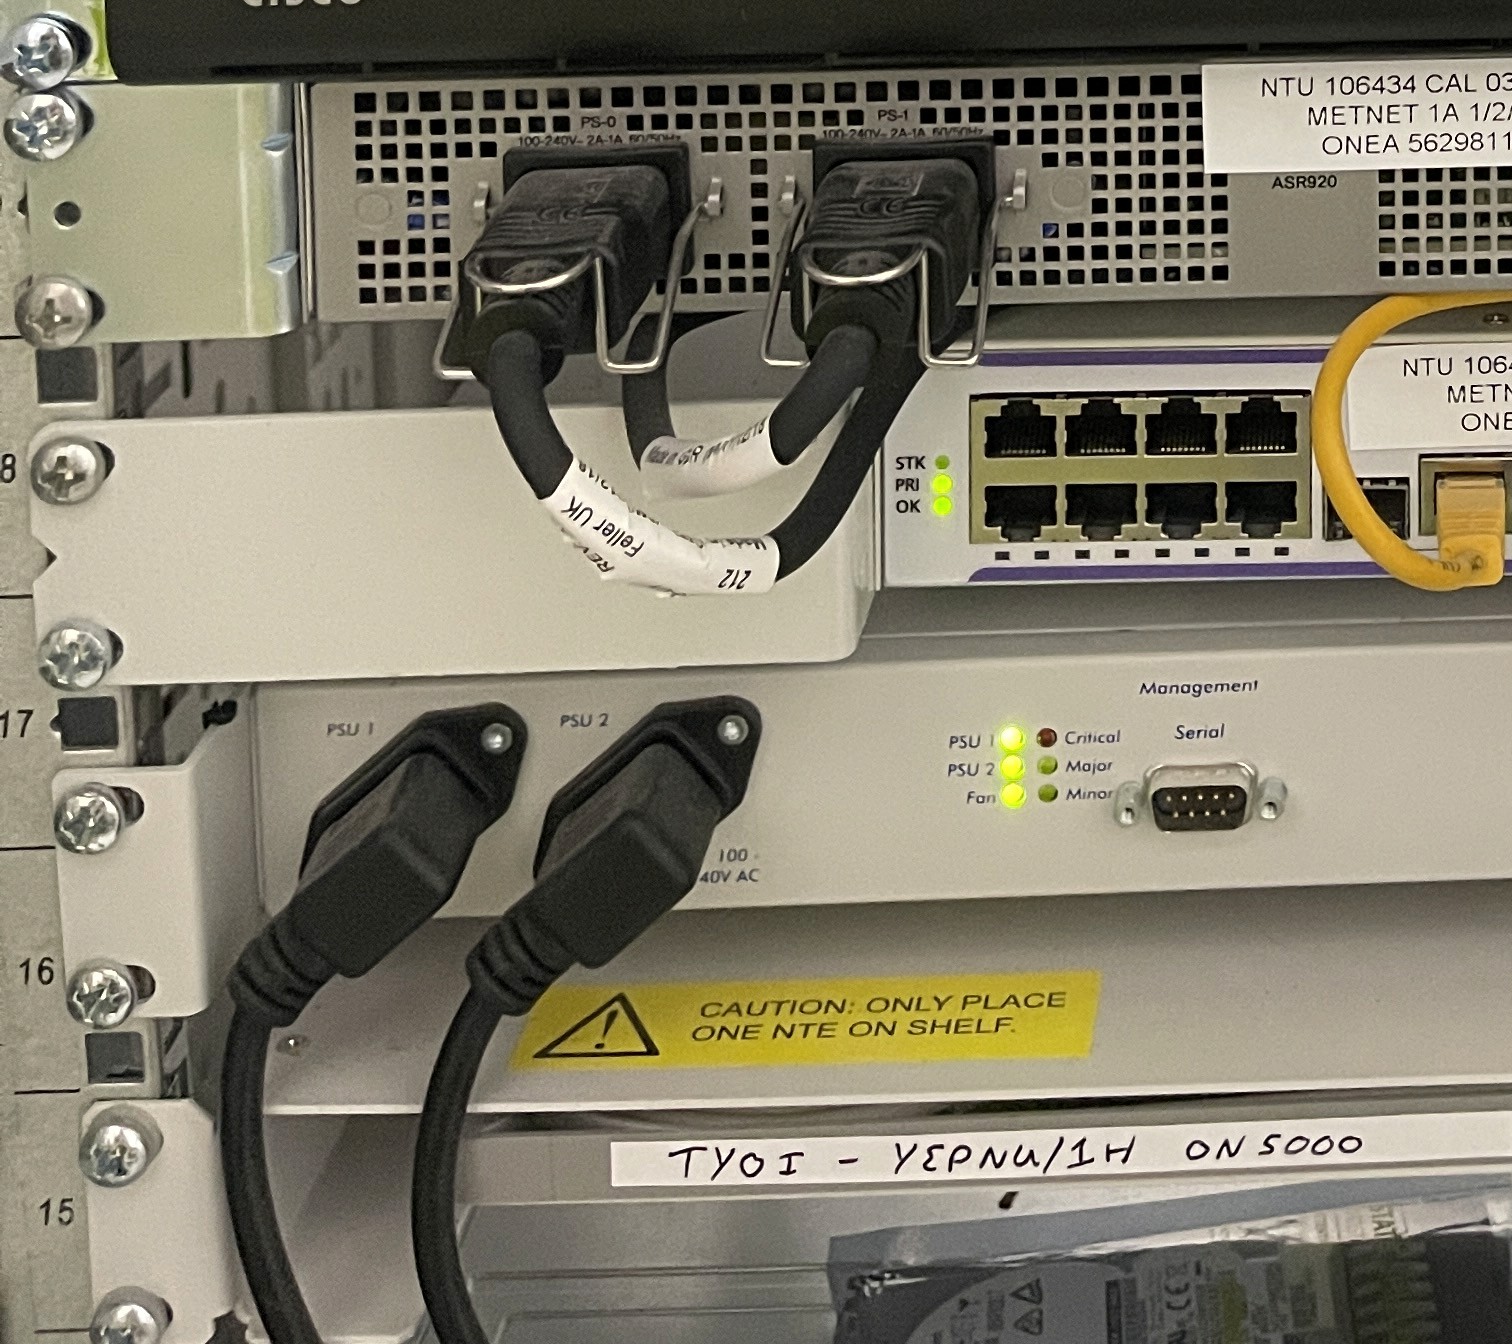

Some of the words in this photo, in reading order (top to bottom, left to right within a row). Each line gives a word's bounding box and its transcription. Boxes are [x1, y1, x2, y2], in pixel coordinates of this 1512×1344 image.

[1261, 76, 1315, 98] NTU
[1325, 73, 1417, 97] 106434
[1423, 71, 1478, 94] CAL
[581, 115, 617, 128] PS-0
[878, 109, 908, 121] PS-1
[1307, 103, 1415, 128] METNET
[1428, 102, 1459, 123] 1A
[1321, 132, 1399, 157] ONEA
[1271, 174, 1338, 190] ASR920
[1403, 356, 1453, 378] NTU
[895, 456, 926, 470] STK
[895, 478, 920, 492] PRI
[561, 496, 593, 527] UK
[895, 499, 921, 513] OK
[591, 517, 645, 558] Feller
[1139, 679, 1259, 698] Management
[560, 714, 594, 728] PSU
[598, 713, 609, 727] 2
[327, 723, 359, 737] PSU
[1064, 730, 1121, 746] Critical
[1175, 723, 1225, 741] Serial
[949, 735, 980, 749] PSU
[948, 764, 979, 777] PSU
[986, 763, 995, 776] 2
[1066, 759, 1113, 776] Major
[966, 791, 996, 805] Fan
[1066, 787, 1114, 802] Minor
[720, 848, 748, 863] 100
[736, 868, 760, 882] AC
[18, 959, 56, 988] 16
[700, 998, 856, 1019] CAUTION:
[866, 993, 953, 1015] ONLY
[961, 990, 1067, 1012] PLACE
[692, 1021, 760, 1043] ONE
[772, 1019, 837, 1040] NTE
[847, 1018, 896, 1039] ON
[907, 1016, 1017, 1037] SHELF.
[38, 1199, 75, 1226] 15
